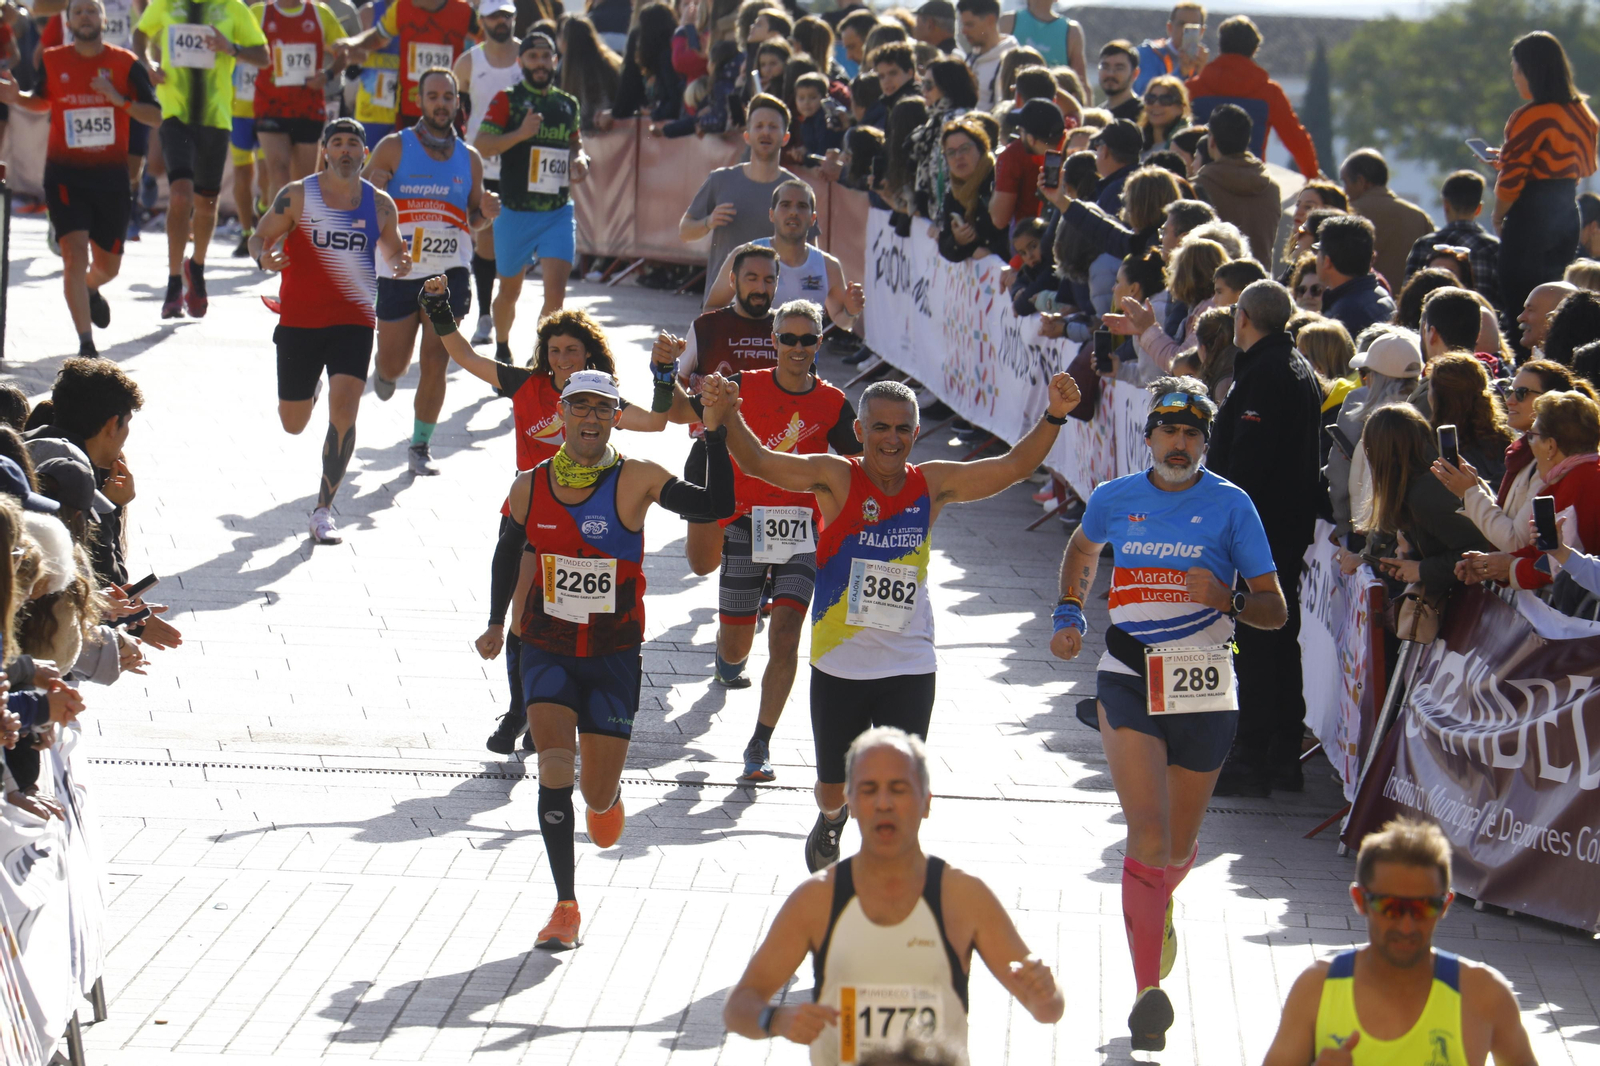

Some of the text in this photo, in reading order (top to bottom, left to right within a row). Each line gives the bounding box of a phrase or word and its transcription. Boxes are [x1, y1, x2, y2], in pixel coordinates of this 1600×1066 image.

[176, 34, 203, 50] 402
[287, 53, 311, 67] 976
[418, 52, 450, 67] 1939
[74, 117, 112, 133] 3455
[541, 158, 566, 174] 1620
[400, 184, 450, 196] enerplus
[407, 200, 446, 210] Maratón
[410, 213, 443, 222] Lucena
[312, 229, 367, 251] USA
[422, 237, 458, 254] 2229
[733, 349, 778, 359] TRAIL
[765, 518, 807, 539] 3071
[858, 530, 923, 548] PALACIEGO
[1121, 541, 1204, 559] enerplus
[563, 558, 592, 568] IMDECO
[874, 564, 901, 575] IMDECO
[556, 568, 611, 594] 2266
[863, 575, 916, 605] 3862
[1139, 590, 1191, 603] Lucena
[1173, 654, 1205, 662] IMDECO
[1173, 666, 1220, 692] 289
[1498, 807, 1572, 857] Deportes
